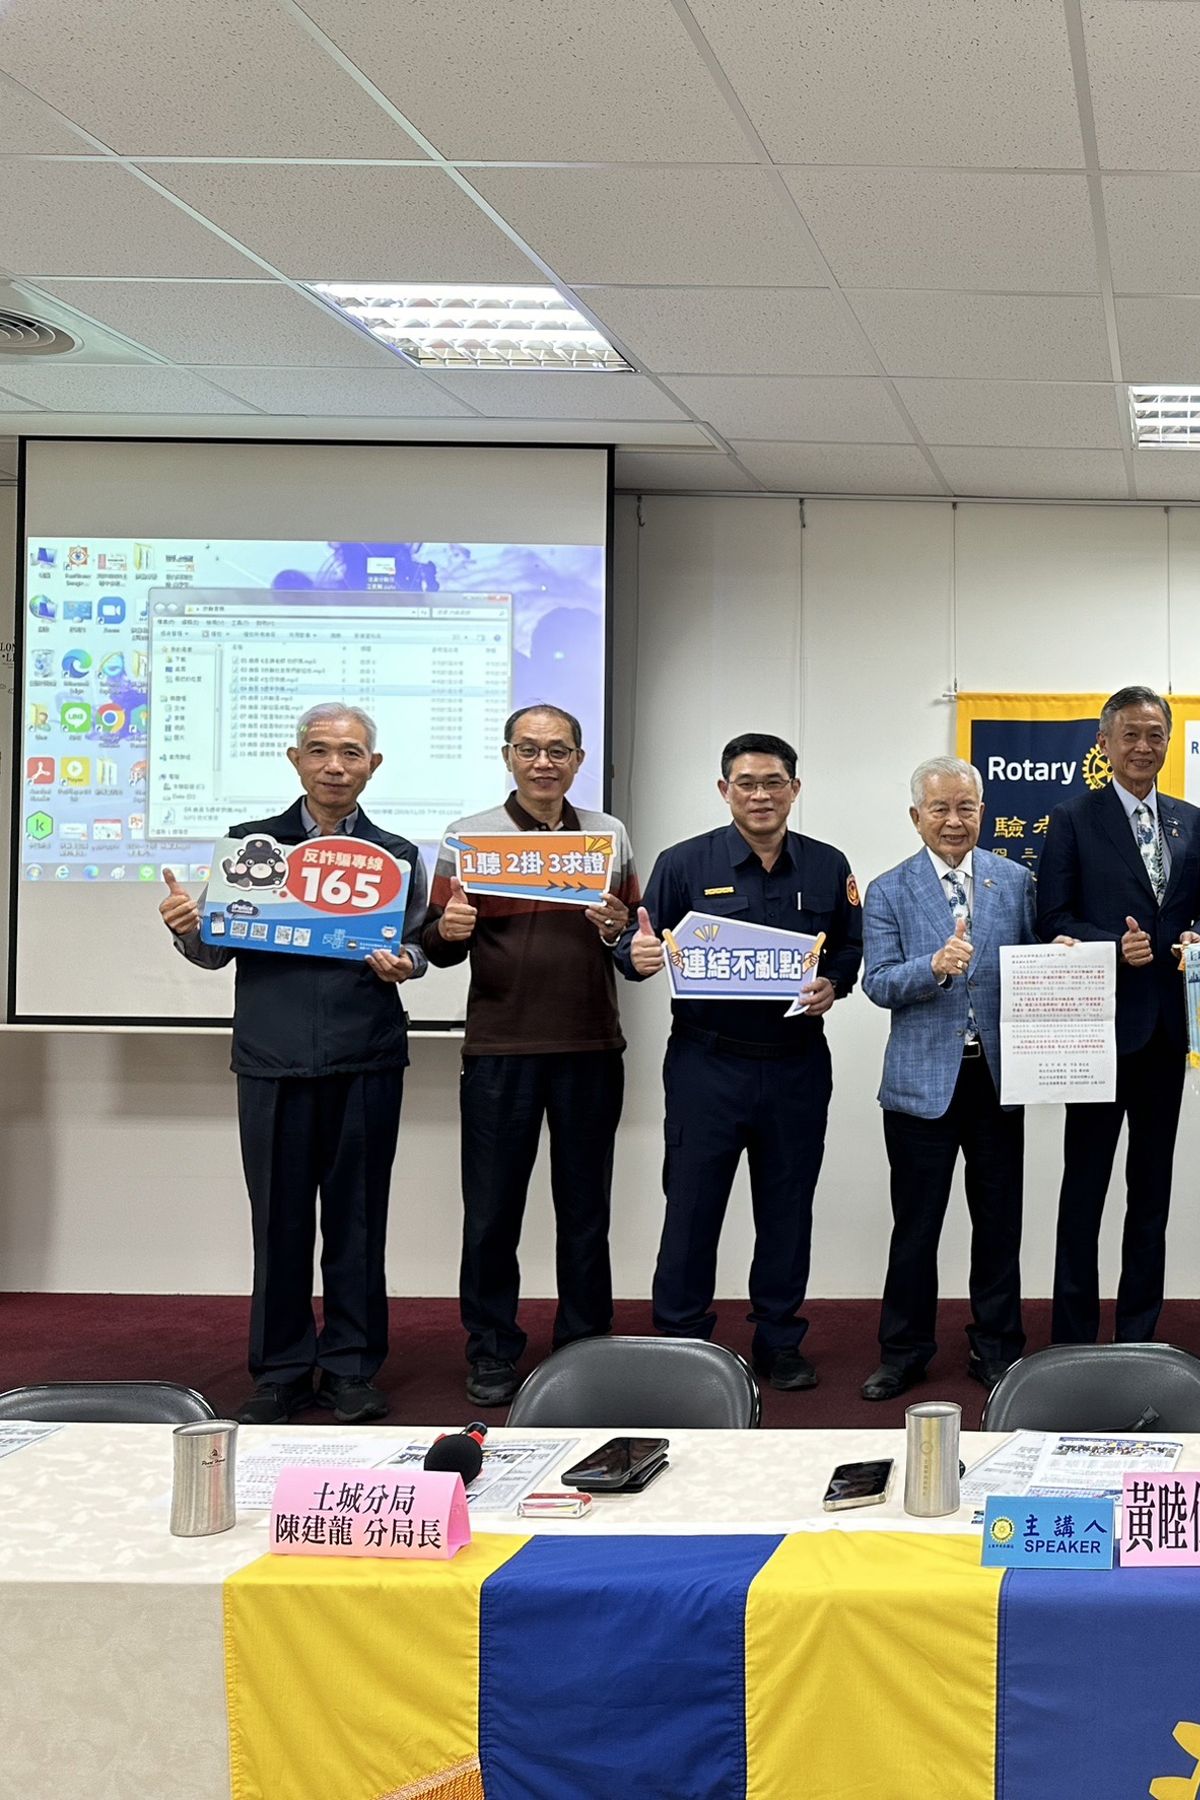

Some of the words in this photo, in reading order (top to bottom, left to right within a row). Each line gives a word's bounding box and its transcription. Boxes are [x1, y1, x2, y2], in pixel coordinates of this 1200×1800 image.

[988, 756, 1077, 785] Rotary
[302, 848, 384, 872] 反詐騙專線
[463, 851, 502, 875] 1聽
[506, 851, 544, 875] 2掛
[548, 851, 606, 875] 3求證
[301, 866, 382, 908] 165
[682, 947, 802, 980] 連結不亂點
[308, 1481, 416, 1516] 土城分局
[275, 1513, 354, 1546] 陳建龍
[363, 1517, 442, 1549] 分局長
[1023, 1514, 1107, 1538] 主講人
[1024, 1539, 1101, 1554] SPEAKER
